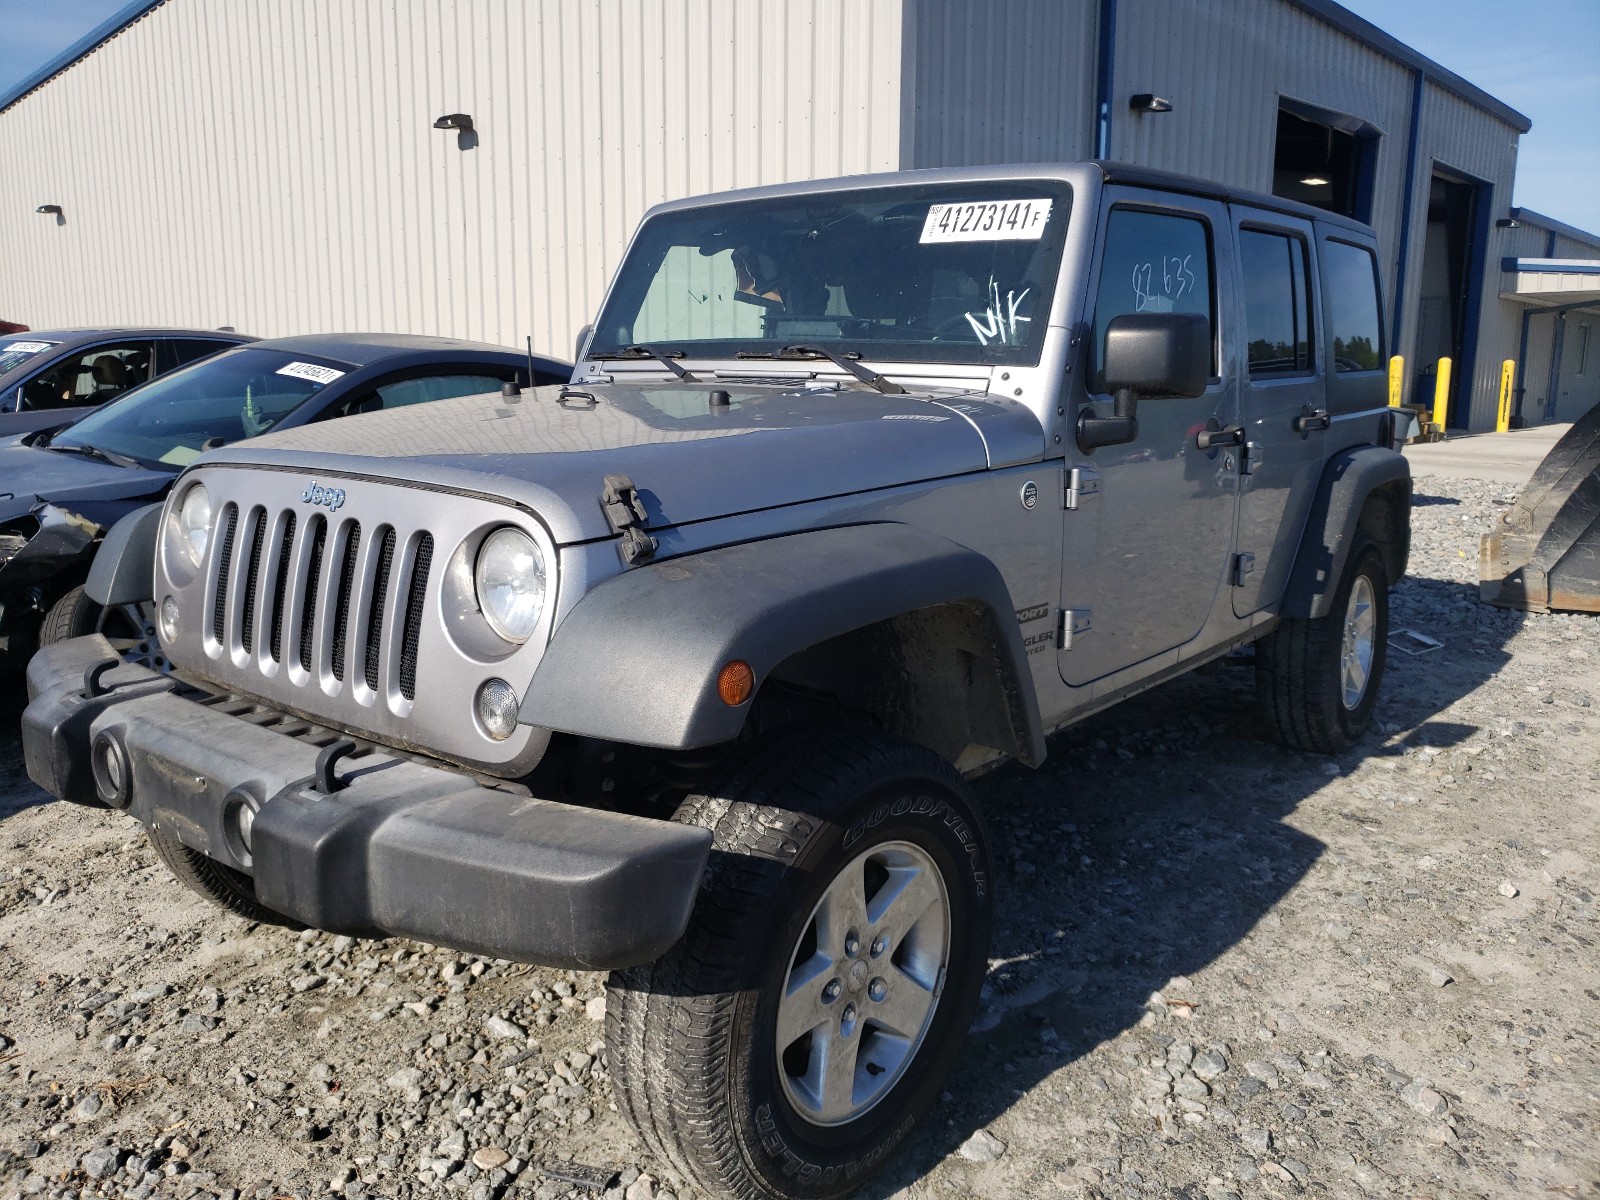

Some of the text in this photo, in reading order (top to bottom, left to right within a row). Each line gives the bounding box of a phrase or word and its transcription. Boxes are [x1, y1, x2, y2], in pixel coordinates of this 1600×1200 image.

[939, 203, 1032, 233] 41273141
[301, 480, 346, 512] Jeep
[1024, 631, 1053, 646] GLER
[843, 797, 986, 896] GOODYEAR
